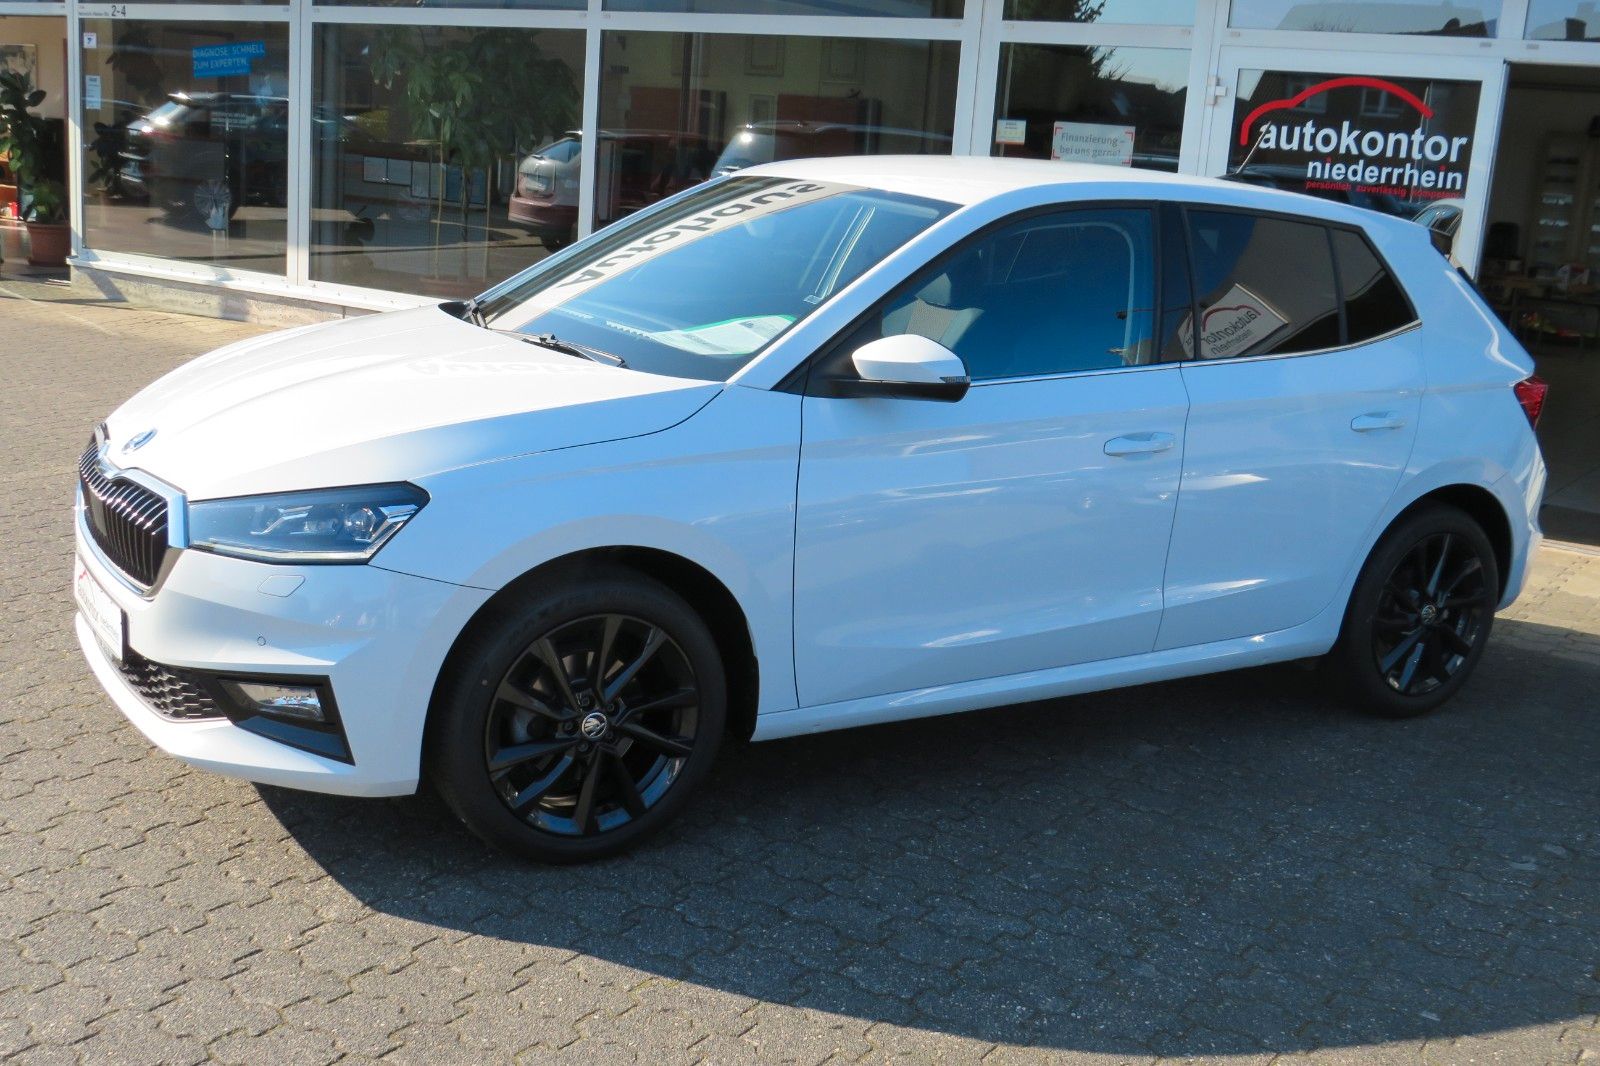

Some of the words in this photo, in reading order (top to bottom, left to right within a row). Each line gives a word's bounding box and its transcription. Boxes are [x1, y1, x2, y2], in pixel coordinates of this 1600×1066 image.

[111, 4, 126, 17] 2-4
[192, 47, 228, 58] DIAGNOSE
[232, 43, 265, 54] SCHNELL
[1061, 132, 1118, 147] Finanzierung
[1259, 118, 1468, 163] autokontor
[1060, 146, 1073, 154] bei
[1306, 157, 1463, 190] niederrhein
[1305, 180, 1352, 191] persönlich
[1356, 184, 1408, 198] zuverlässig
